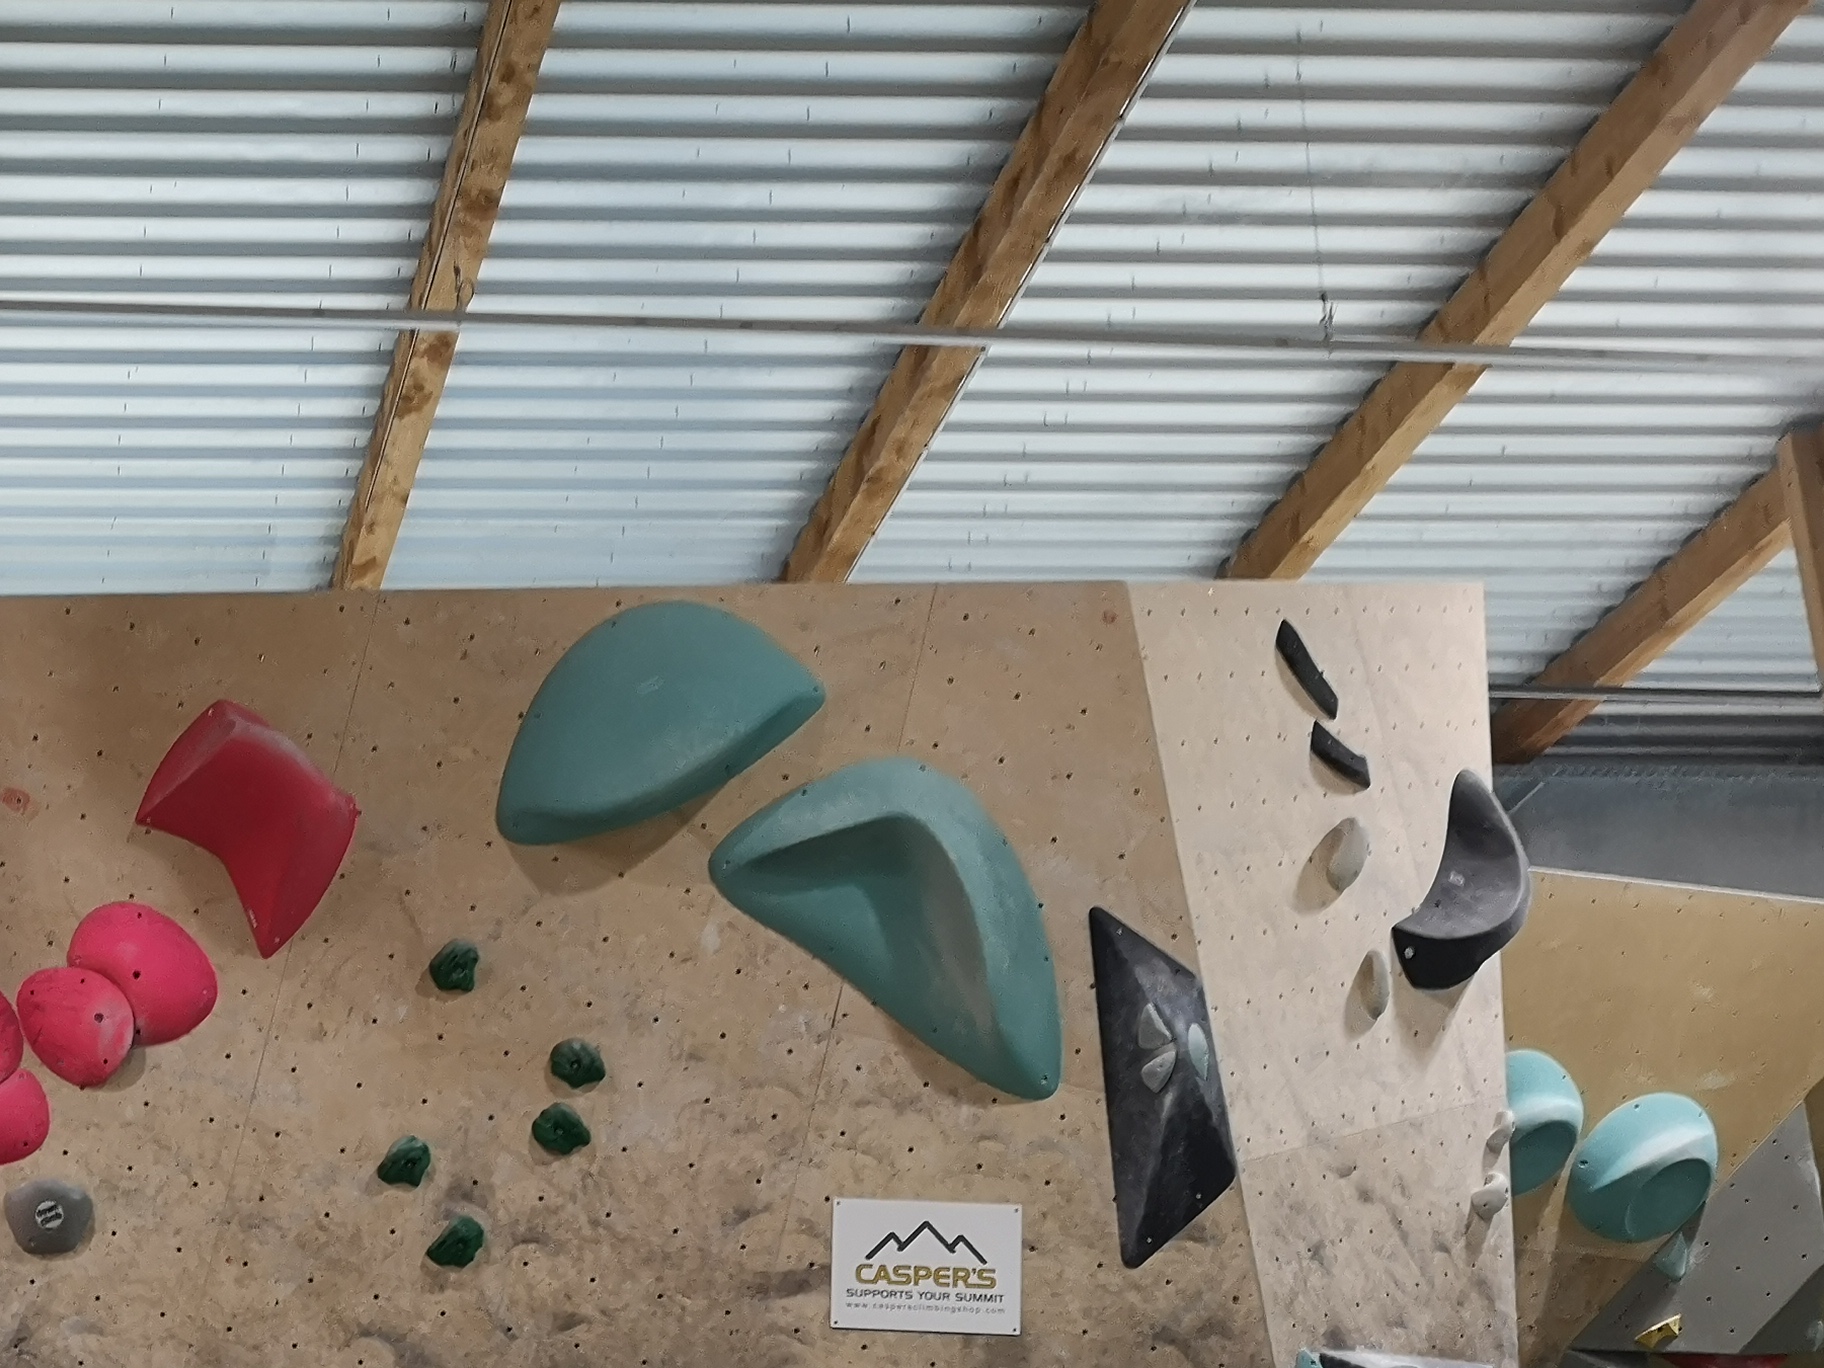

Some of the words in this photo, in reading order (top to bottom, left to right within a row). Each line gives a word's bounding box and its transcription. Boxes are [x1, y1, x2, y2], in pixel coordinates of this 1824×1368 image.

[855, 1263, 997, 1289] CASPER'S
[846, 1288, 913, 1300] SUPPORTS
[917, 1291, 951, 1301] YOUR
[955, 1292, 1005, 1304] SUMMIT
